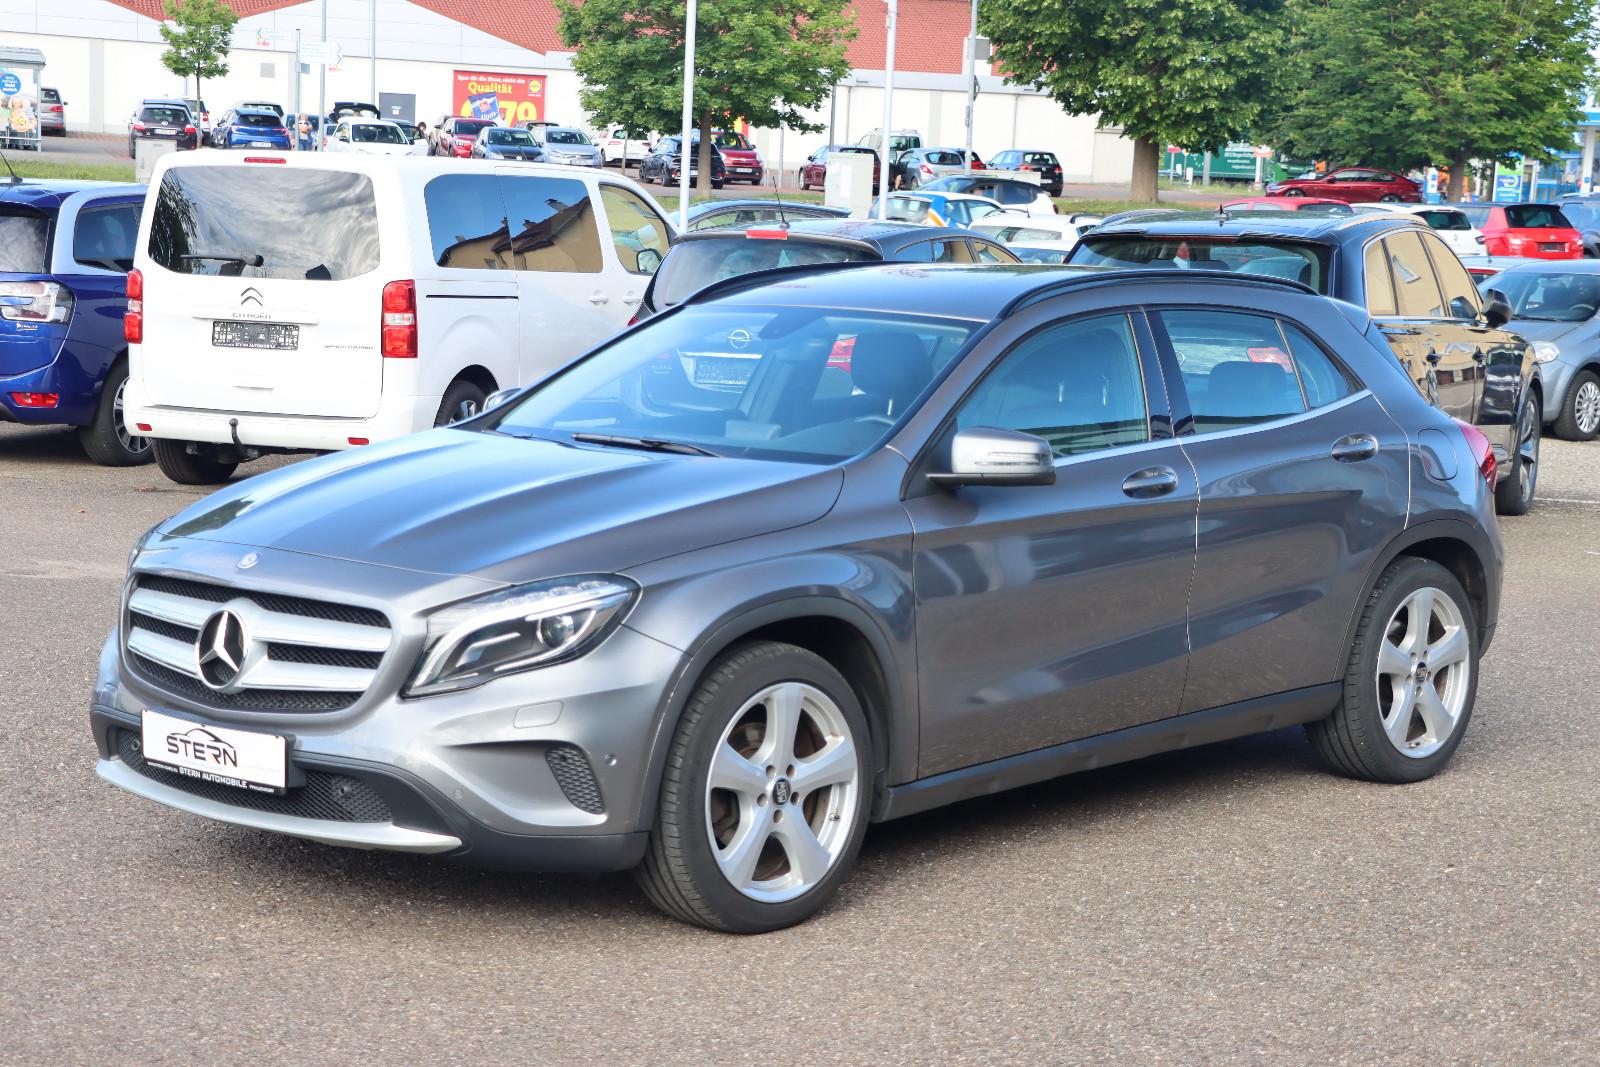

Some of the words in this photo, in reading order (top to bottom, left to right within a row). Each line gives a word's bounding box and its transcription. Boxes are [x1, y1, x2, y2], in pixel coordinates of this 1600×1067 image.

[467, 82, 513, 94] Qualität
[166, 735, 238, 767] STERN
[179, 767, 200, 778] STERN
[202, 772, 248, 788] AUTOMOBILE
